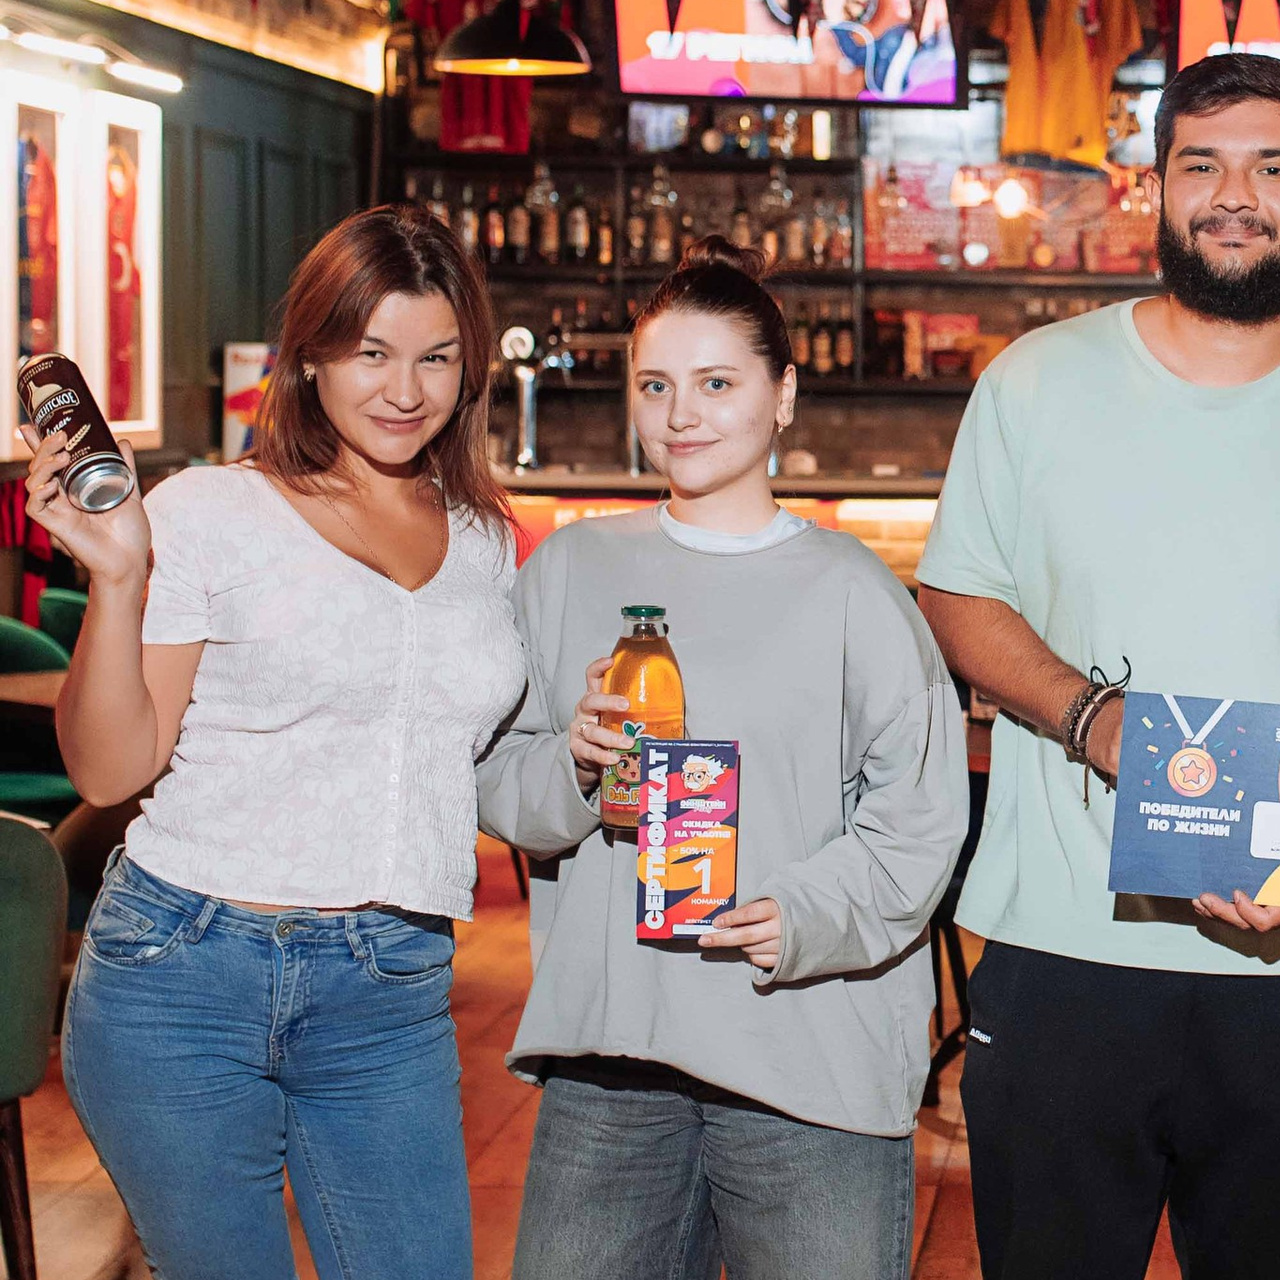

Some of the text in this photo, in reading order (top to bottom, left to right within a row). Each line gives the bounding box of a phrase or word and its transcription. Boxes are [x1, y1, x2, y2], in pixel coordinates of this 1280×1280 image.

[1139, 801, 1241, 823] ПОБЕДИТЕЛИ
[1147, 817, 1231, 837] ПО ЖИЗНИ
[645, 748, 669, 930] СЕРТИФИКАТ
[692, 857, 712, 895] 1
[691, 898, 730, 906] КОМАНДУ
